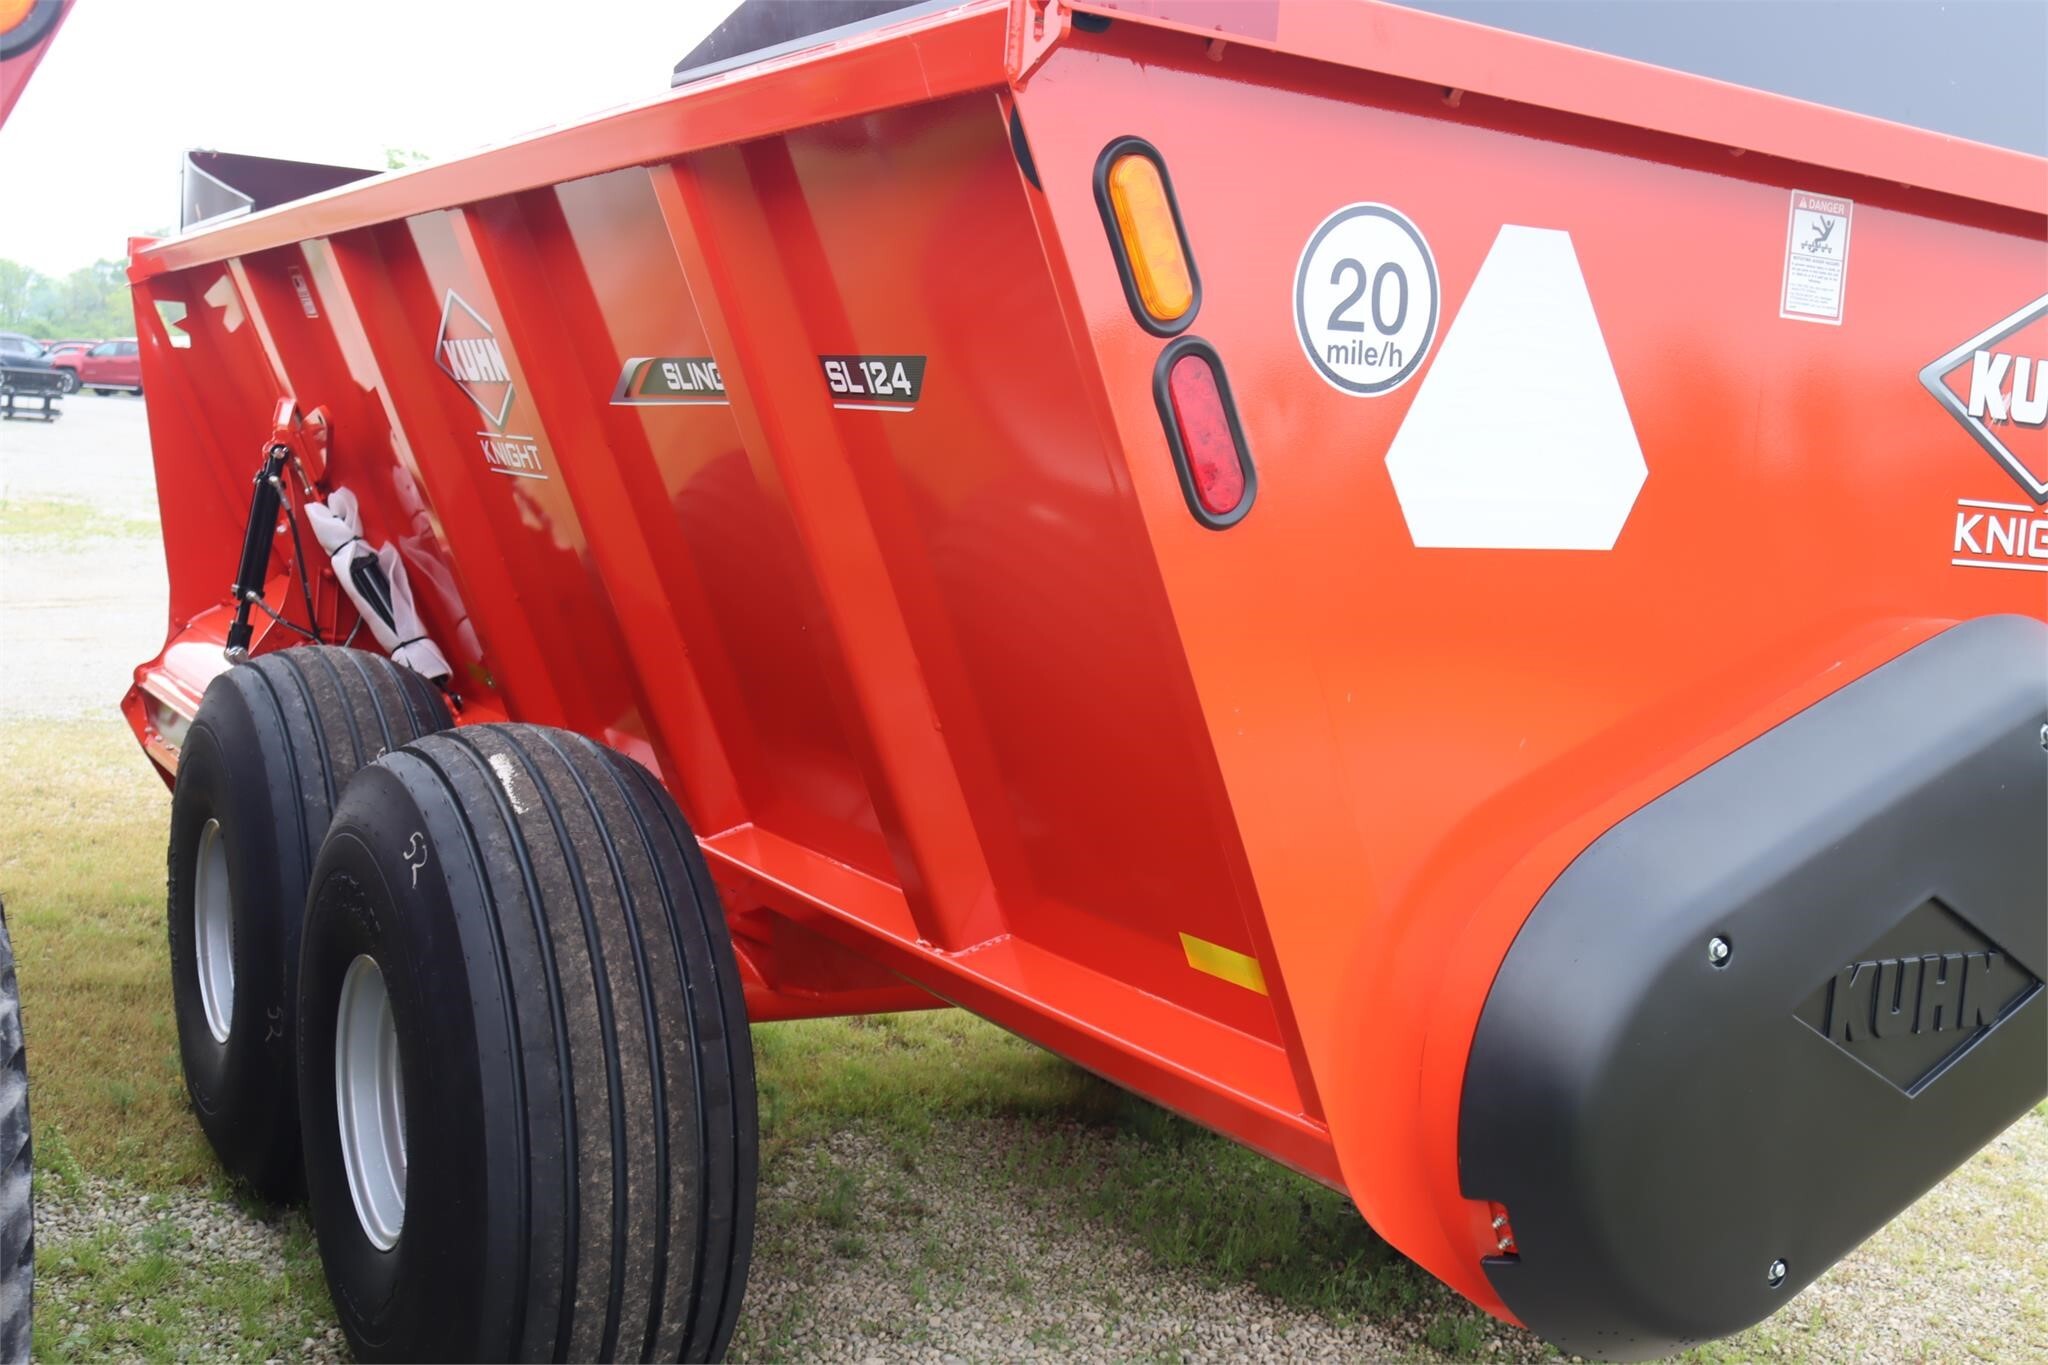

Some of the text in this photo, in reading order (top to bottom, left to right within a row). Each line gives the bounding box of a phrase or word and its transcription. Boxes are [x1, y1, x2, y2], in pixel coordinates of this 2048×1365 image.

[1808, 198, 1845, 216] DANGER
[1327, 258, 1408, 336] 20
[442, 337, 512, 382] KUHN
[1326, 340, 1403, 367] mile/h
[662, 361, 725, 391] SLING
[479, 439, 543, 471] KNIGHT
[1822, 951, 2001, 1042] KUHN
